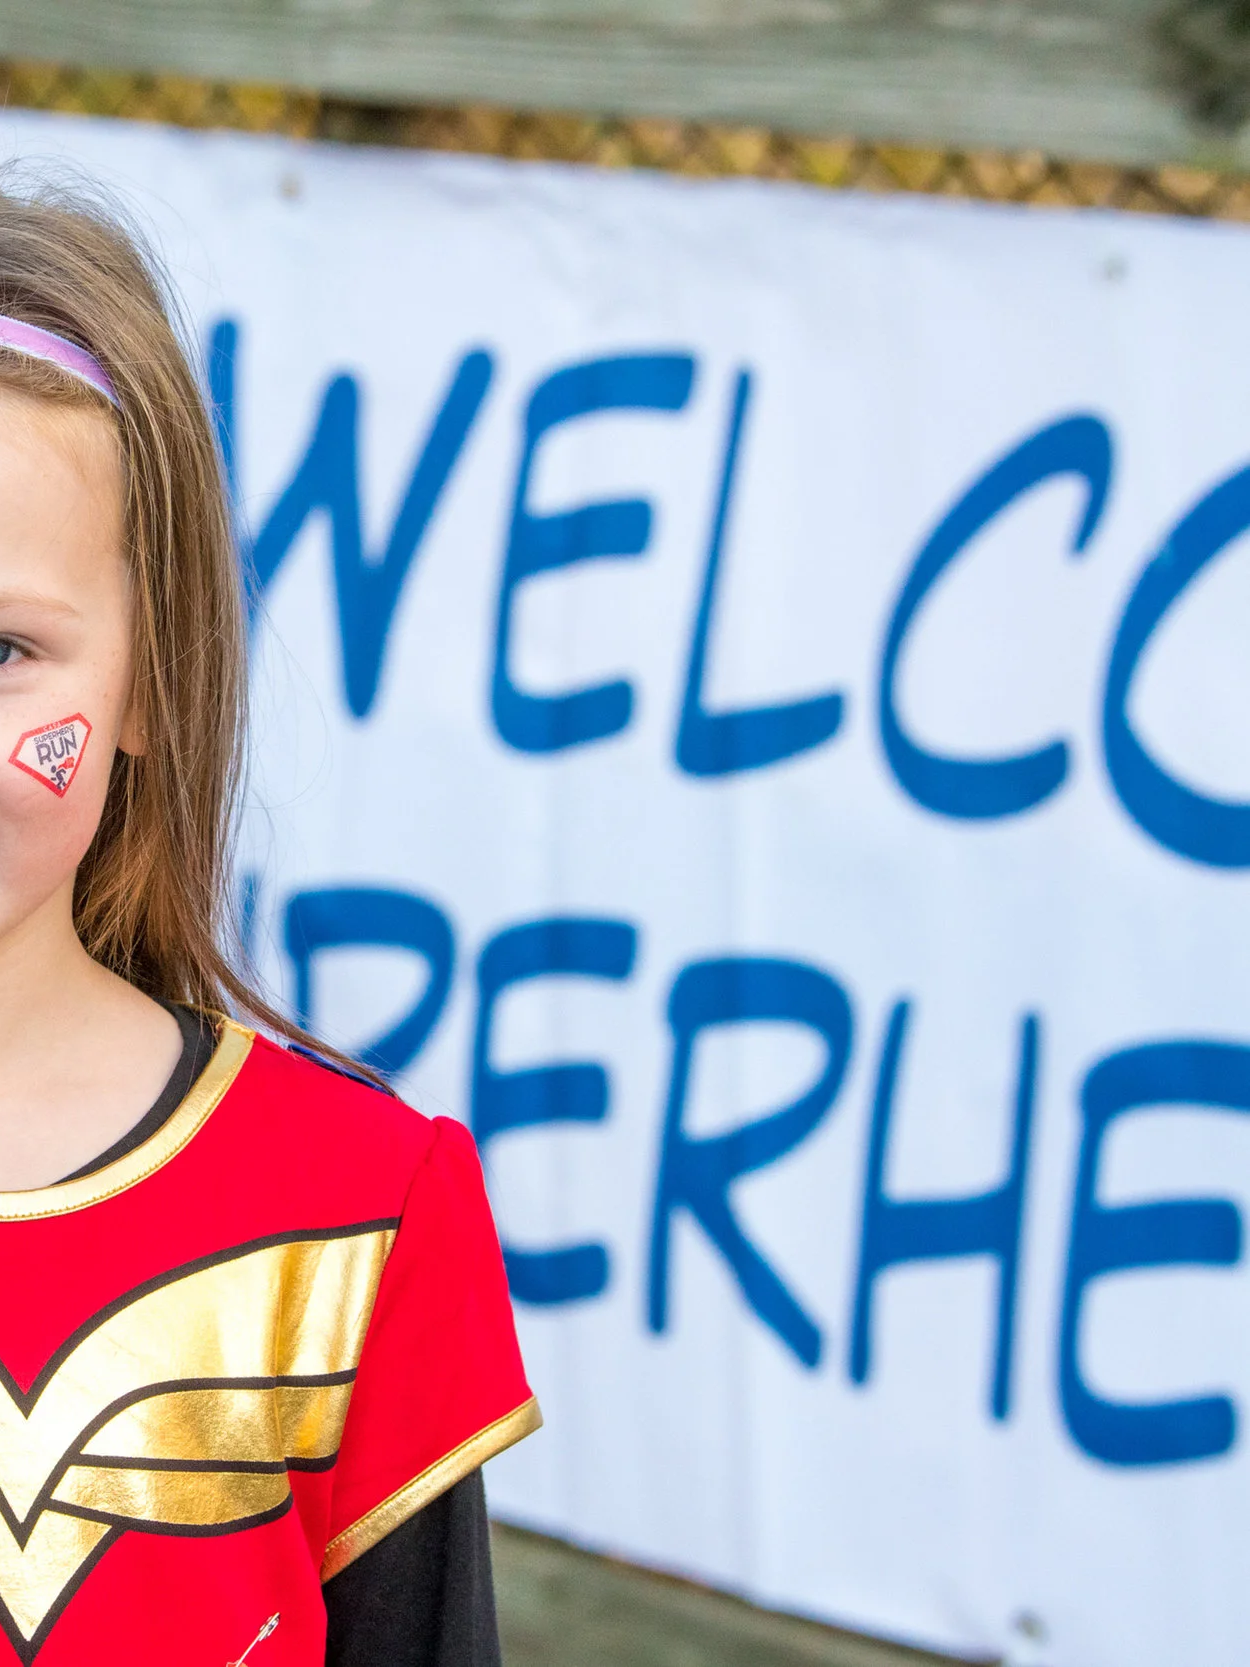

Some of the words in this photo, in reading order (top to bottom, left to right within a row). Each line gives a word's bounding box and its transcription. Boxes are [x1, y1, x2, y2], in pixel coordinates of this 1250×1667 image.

[34, 724, 74, 744] SUPERHERO
[36, 731, 77, 765] RUN
[240, 870, 1250, 1468] PERHE
